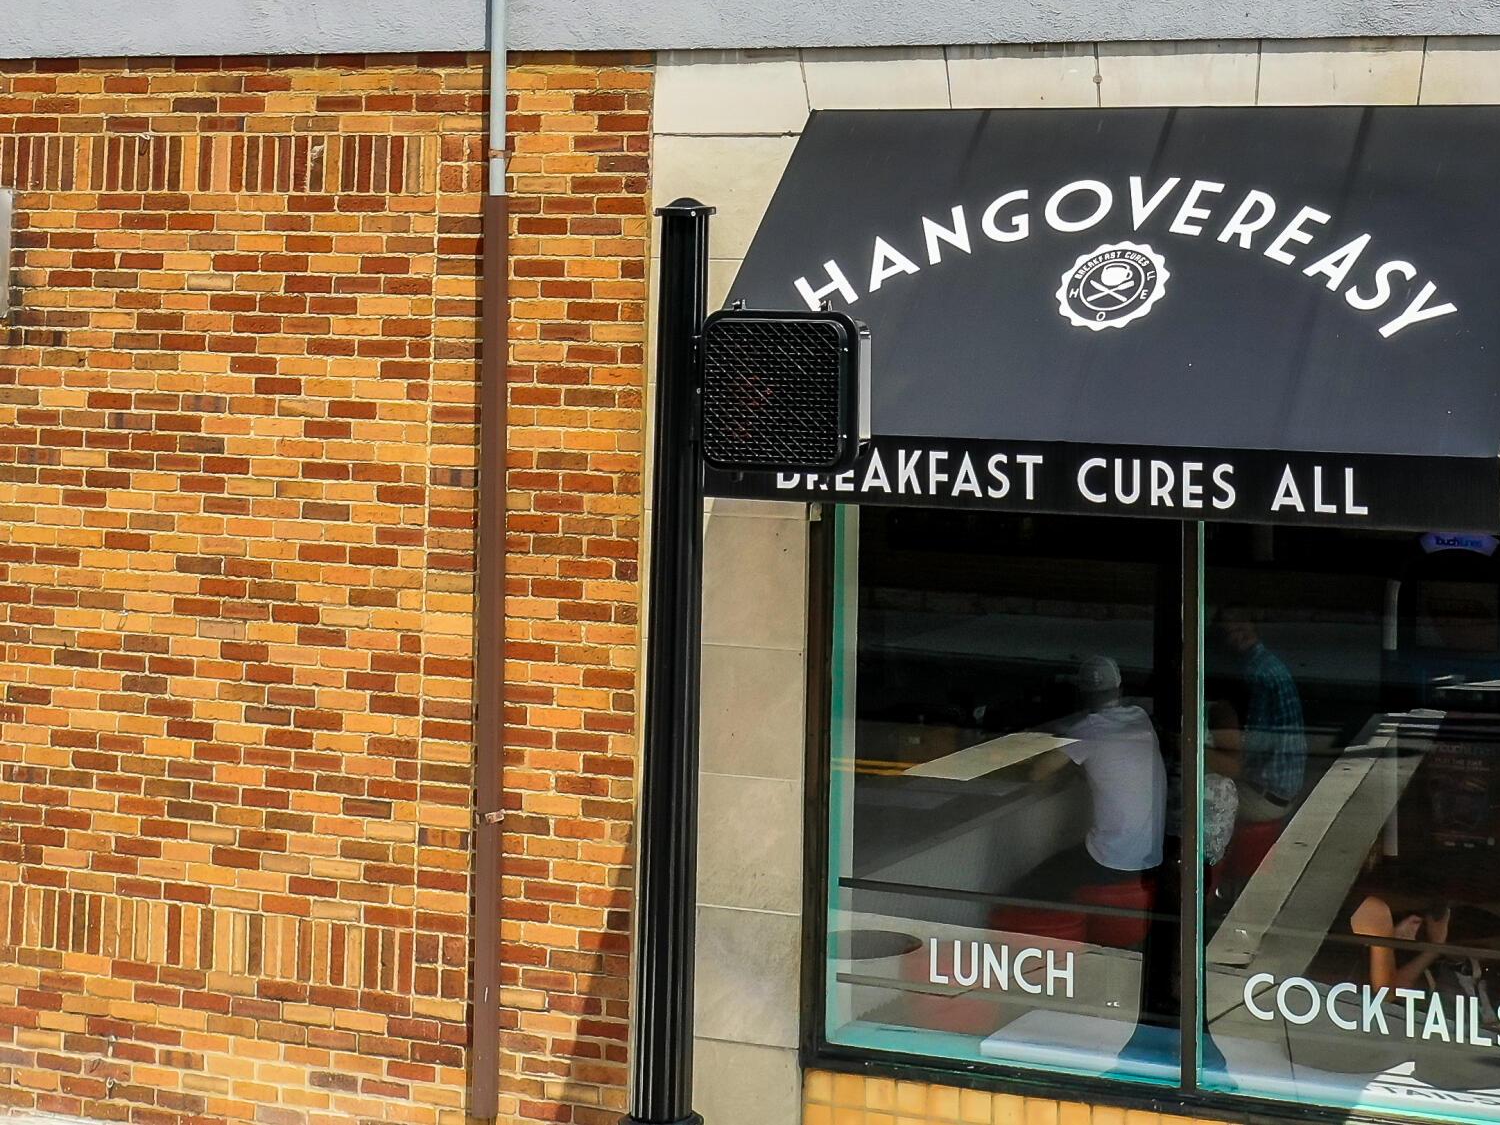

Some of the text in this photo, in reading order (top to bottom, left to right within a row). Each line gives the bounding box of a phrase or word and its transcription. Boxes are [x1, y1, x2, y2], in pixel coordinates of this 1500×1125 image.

[793, 175, 1459, 340] HANGOVEREASY
[1074, 251, 1121, 280] BREAKFAST
[1124, 251, 1149, 267] CURES
[1077, 457, 1236, 510] CURES
[1270, 463, 1369, 516] ALL
[928, 937, 1076, 999] LUNCH
